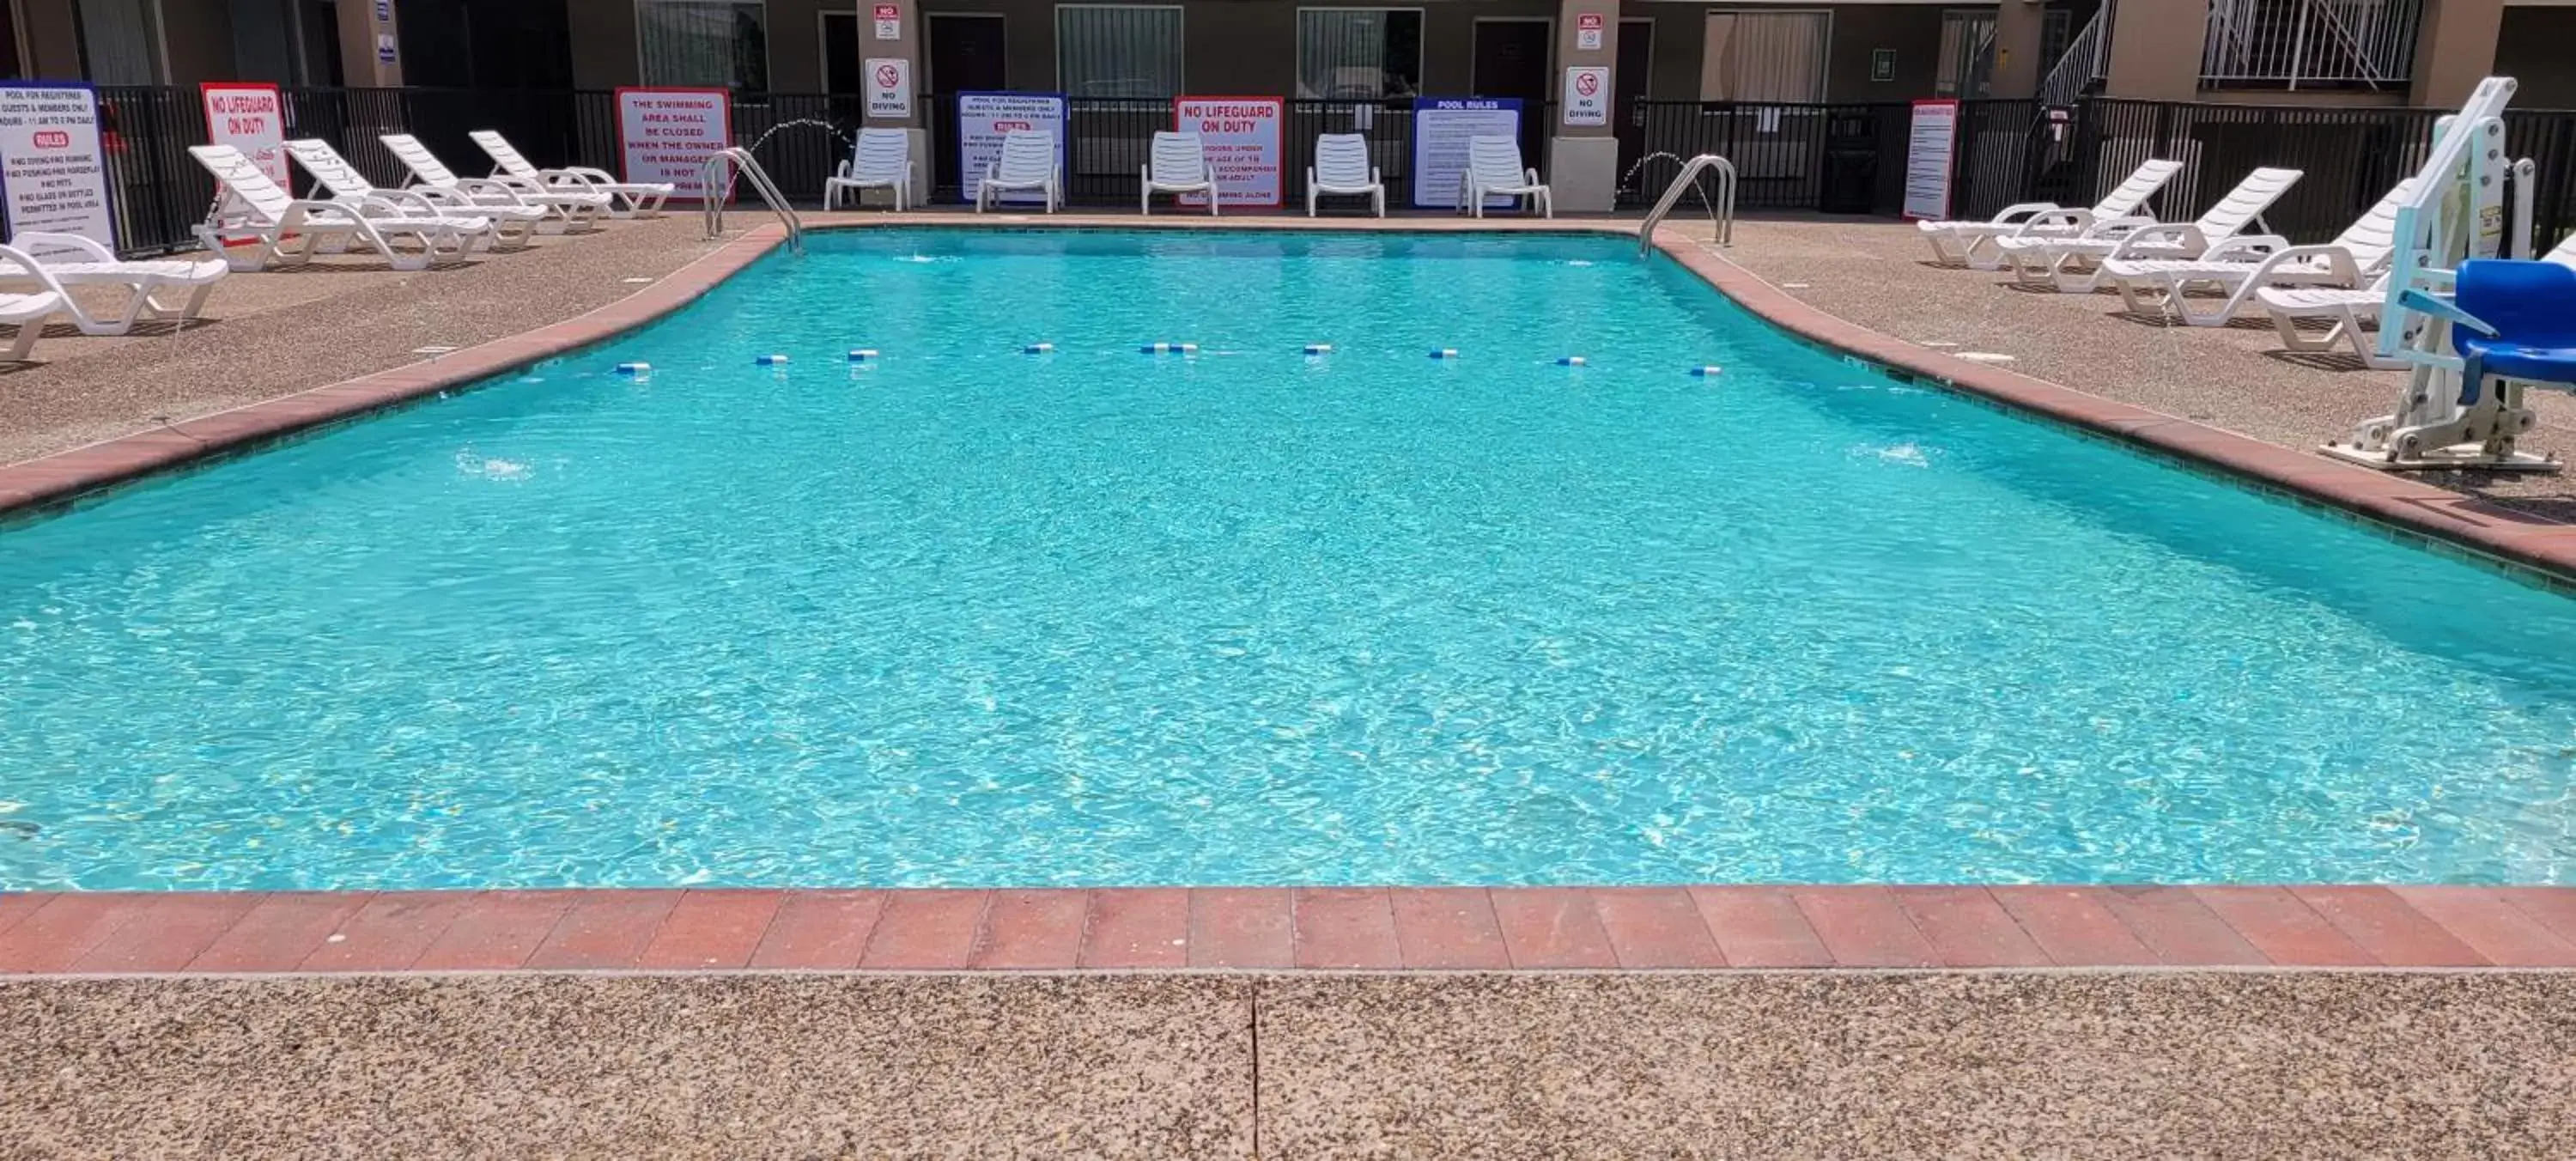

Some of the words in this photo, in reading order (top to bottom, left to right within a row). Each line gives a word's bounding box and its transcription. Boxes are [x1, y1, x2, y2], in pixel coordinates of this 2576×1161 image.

[5, 91, 24, 100] POOL
[27, 91, 39, 100] FOR
[882, 92, 896, 100] NO
[211, 96, 226, 113] NO
[227, 96, 275, 113] LIFEGUARD
[633, 100, 653, 109] THE
[657, 100, 714, 109] SWIMMING
[872, 102, 906, 111] DIVING
[1437, 100, 1464, 109] POOL
[1466, 100, 1498, 109] RULES
[1579, 99, 1593, 107] NO
[2, 104, 29, 112] GUESTS
[1184, 106, 1202, 118] NO
[1206, 106, 1273, 118] LIFEGUARD
[642, 114, 670, 123] AREA
[672, 114, 707, 123] SHALL
[228, 118, 241, 135] ON
[243, 117, 265, 135] DUTY
[1201, 120, 1219, 133] ON
[1224, 120, 1257, 133] DUTY
[645, 128, 660, 137] BE
[662, 128, 704, 137] CLOSED
[36, 133, 67, 145] RULES
[685, 142, 724, 150] OWNER
[674, 168, 696, 177] NOT
